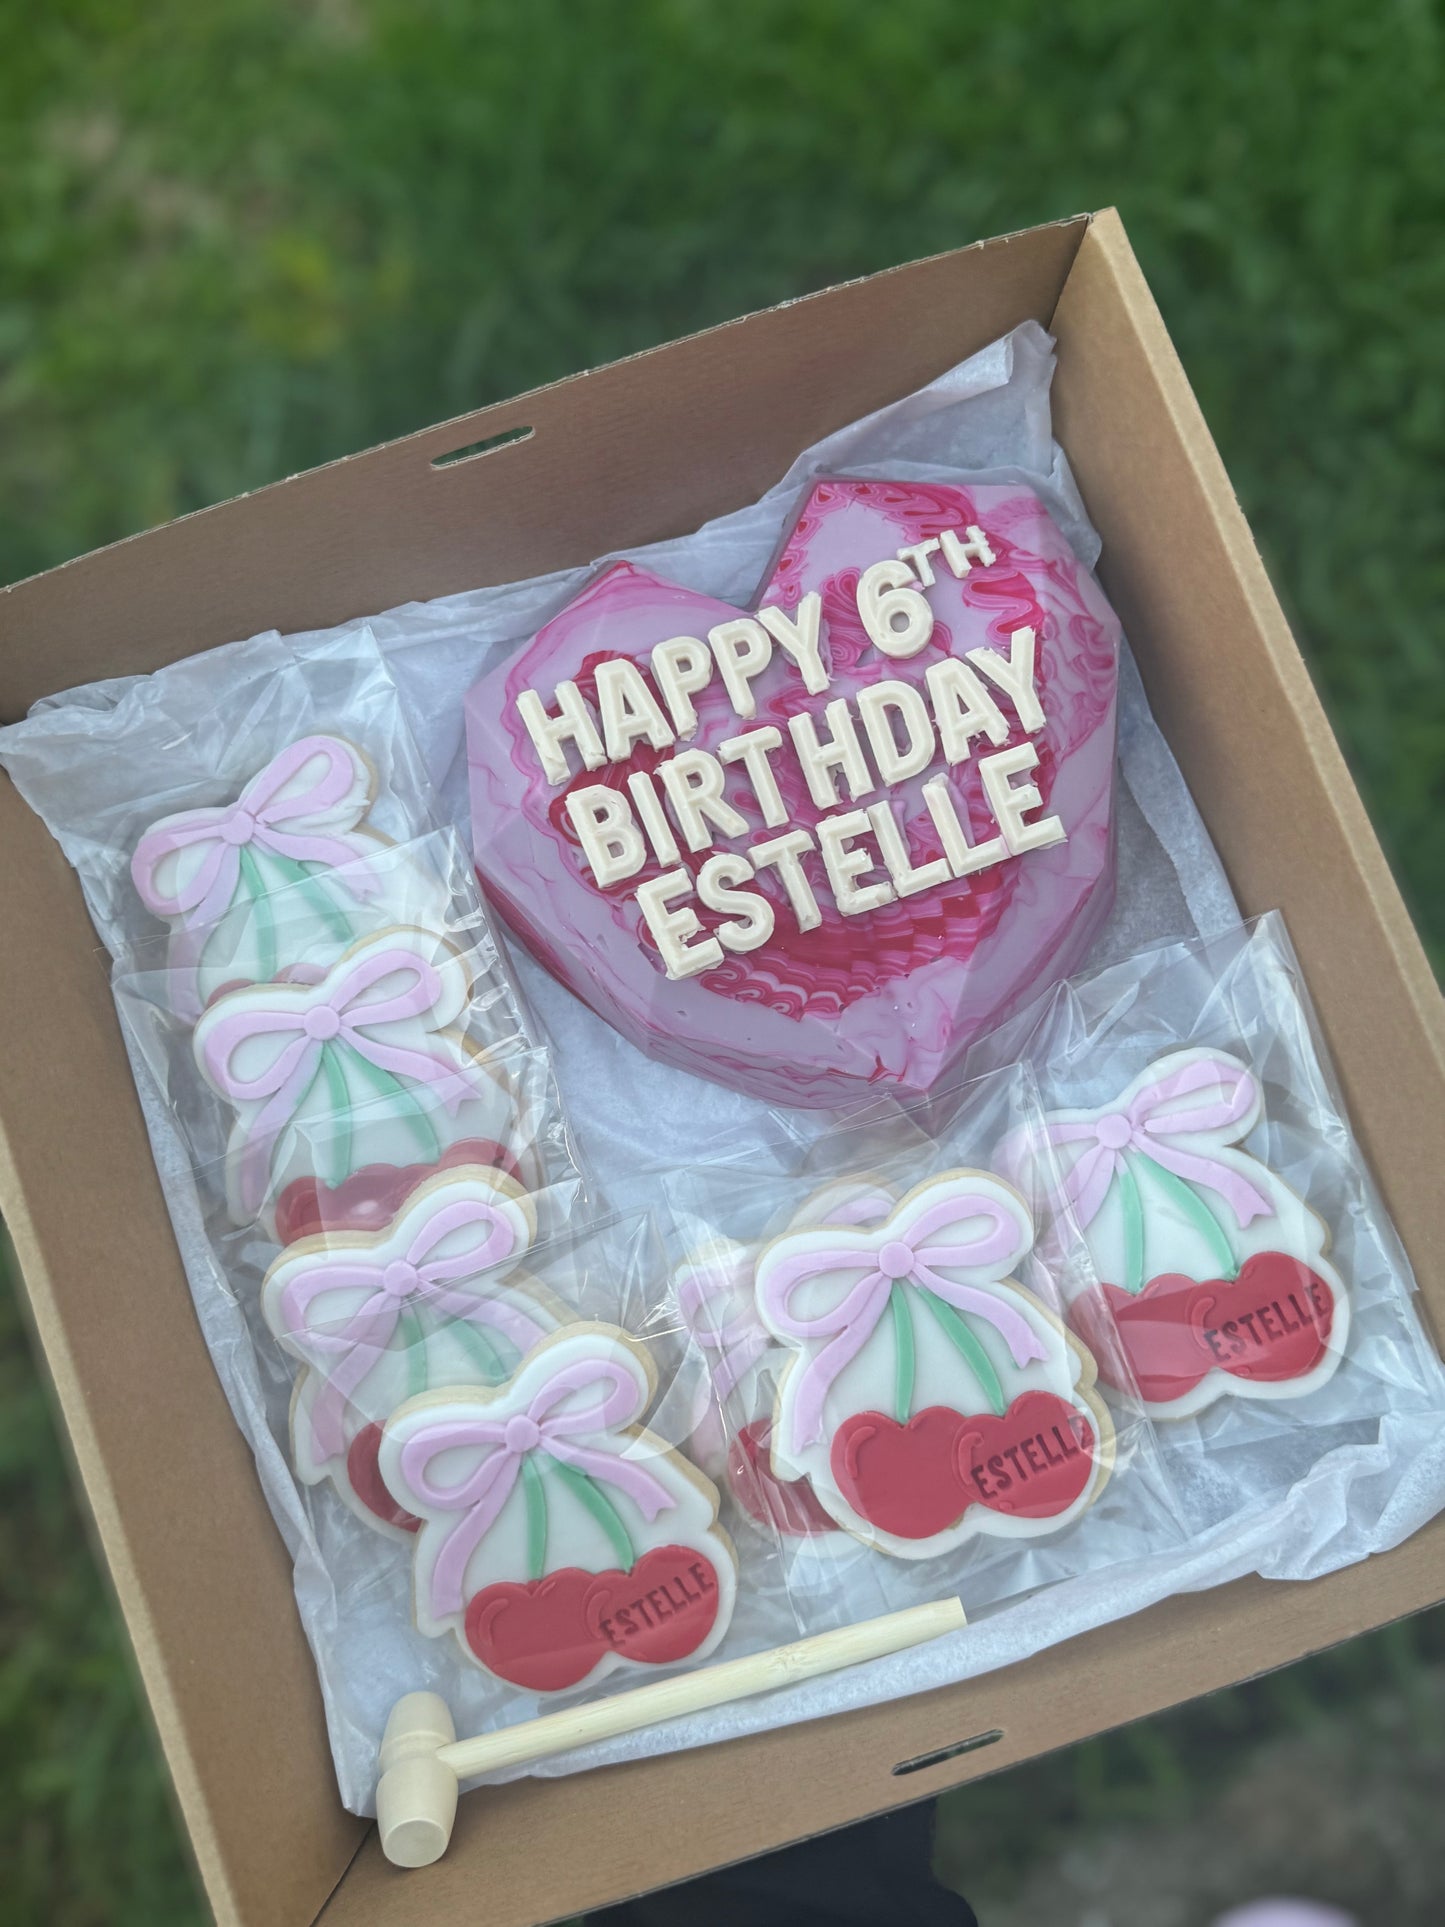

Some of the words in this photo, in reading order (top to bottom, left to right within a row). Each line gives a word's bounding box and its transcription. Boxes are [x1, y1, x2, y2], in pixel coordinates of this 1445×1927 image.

[516, 590, 831, 786] HAPPY
[856, 525, 997, 659] 6TH
[565, 626, 1046, 889] BIRTHDAY
[634, 742, 1068, 981] ESTELLE
[1203, 1283, 1329, 1362] ESTELLE
[598, 1562, 715, 1646] ESTELLE
